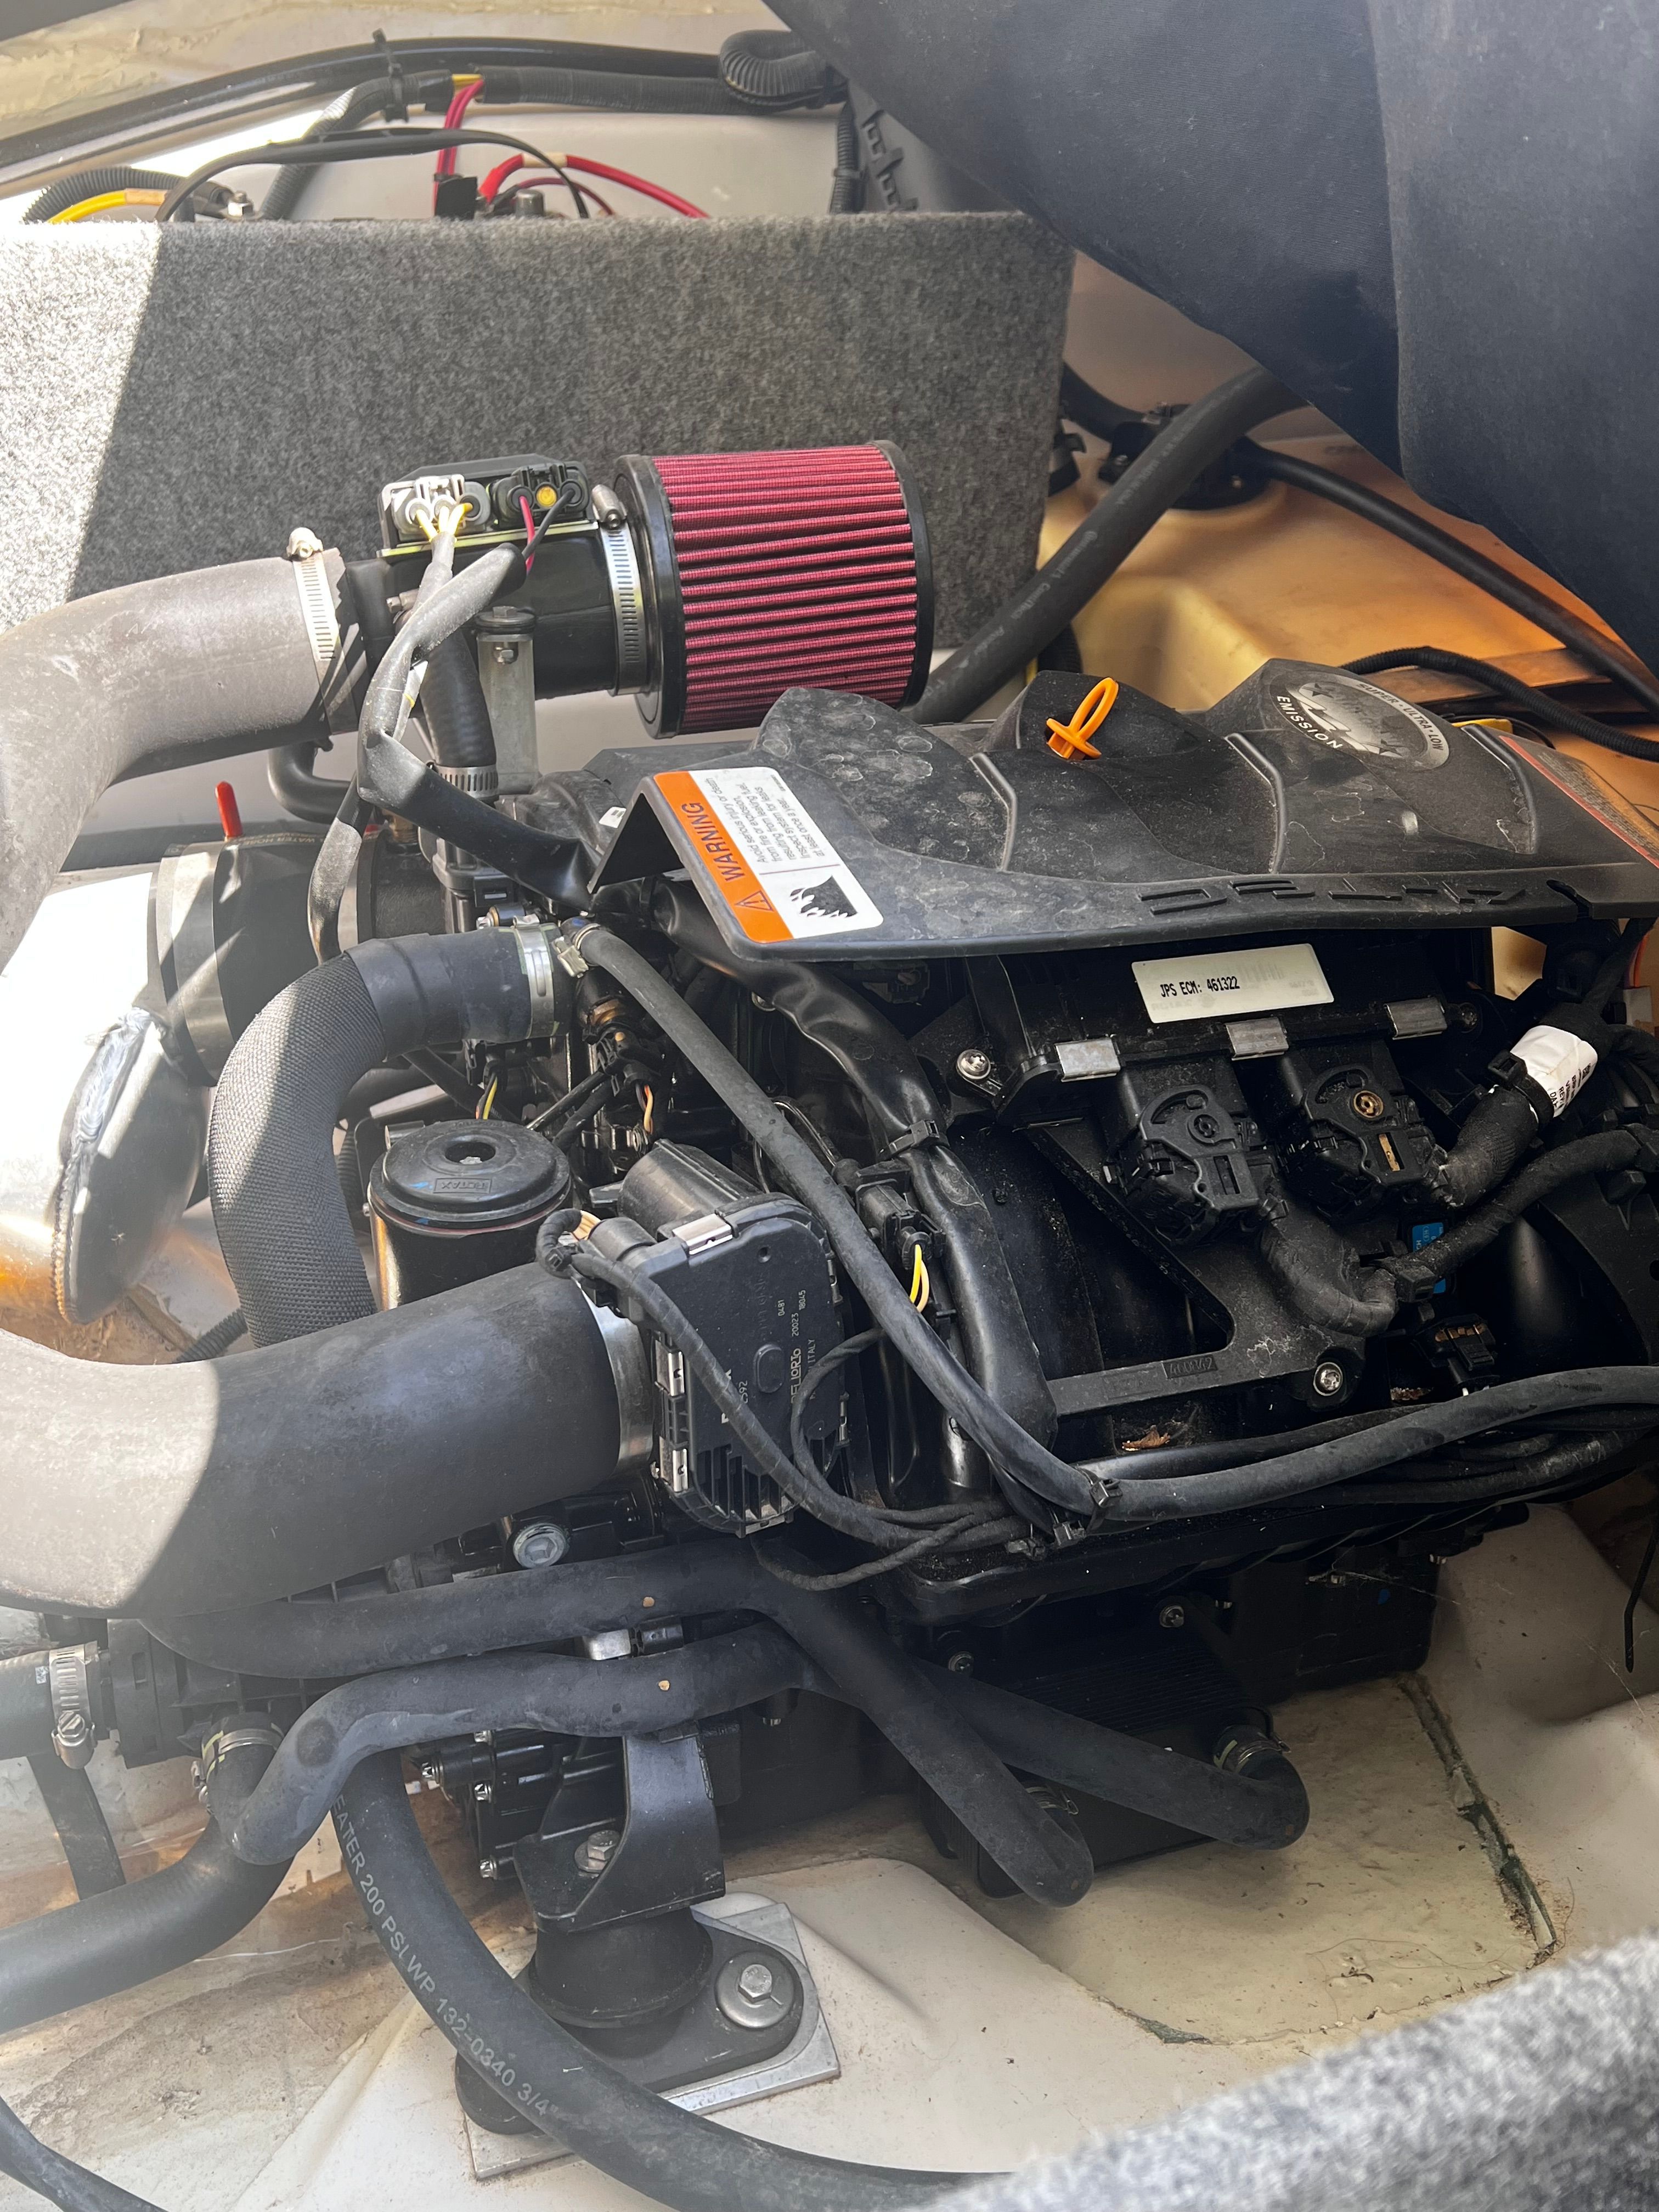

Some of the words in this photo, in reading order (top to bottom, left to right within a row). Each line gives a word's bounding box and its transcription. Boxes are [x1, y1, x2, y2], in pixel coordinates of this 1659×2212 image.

[1276, 695, 1343, 749] EMISSION
[1356, 683, 1398, 703] SUPER
[1402, 707, 1431, 729] ULTRA
[1427, 733, 1444, 751] LOW
[706, 777, 723, 794] death
[754, 786, 771, 802] leaks
[721, 803, 740, 820] injury
[747, 795, 767, 818] leaking
[766, 803, 777, 812] for
[735, 821, 755, 844] serious
[753, 826, 764, 834] or
[761, 818, 778, 832] from
[772, 812, 794, 834] system
[791, 819, 808, 833] once
[681, 802, 745, 882] WARNING
[759, 834, 772, 845] fire
[772, 832, 797, 860] resulting
[788, 835, 810, 859] Inspect
[801, 834, 820, 849] least
[747, 845, 769, 863] Avoid
[766, 846, 783, 862] from
[1160, 983, 1177, 998] JPS
[1179, 980, 1203, 996] ECM:
[1206, 976, 1240, 992] 461322
[808, 1339, 816, 1363] ITALY
[331, 1795, 365, 1875] EATER
[360, 1874, 386, 1916] 200
[382, 1915, 408, 1961] PSI
[407, 1953, 436, 1995] WP
[436, 1997, 516, 2087] 132-0340
